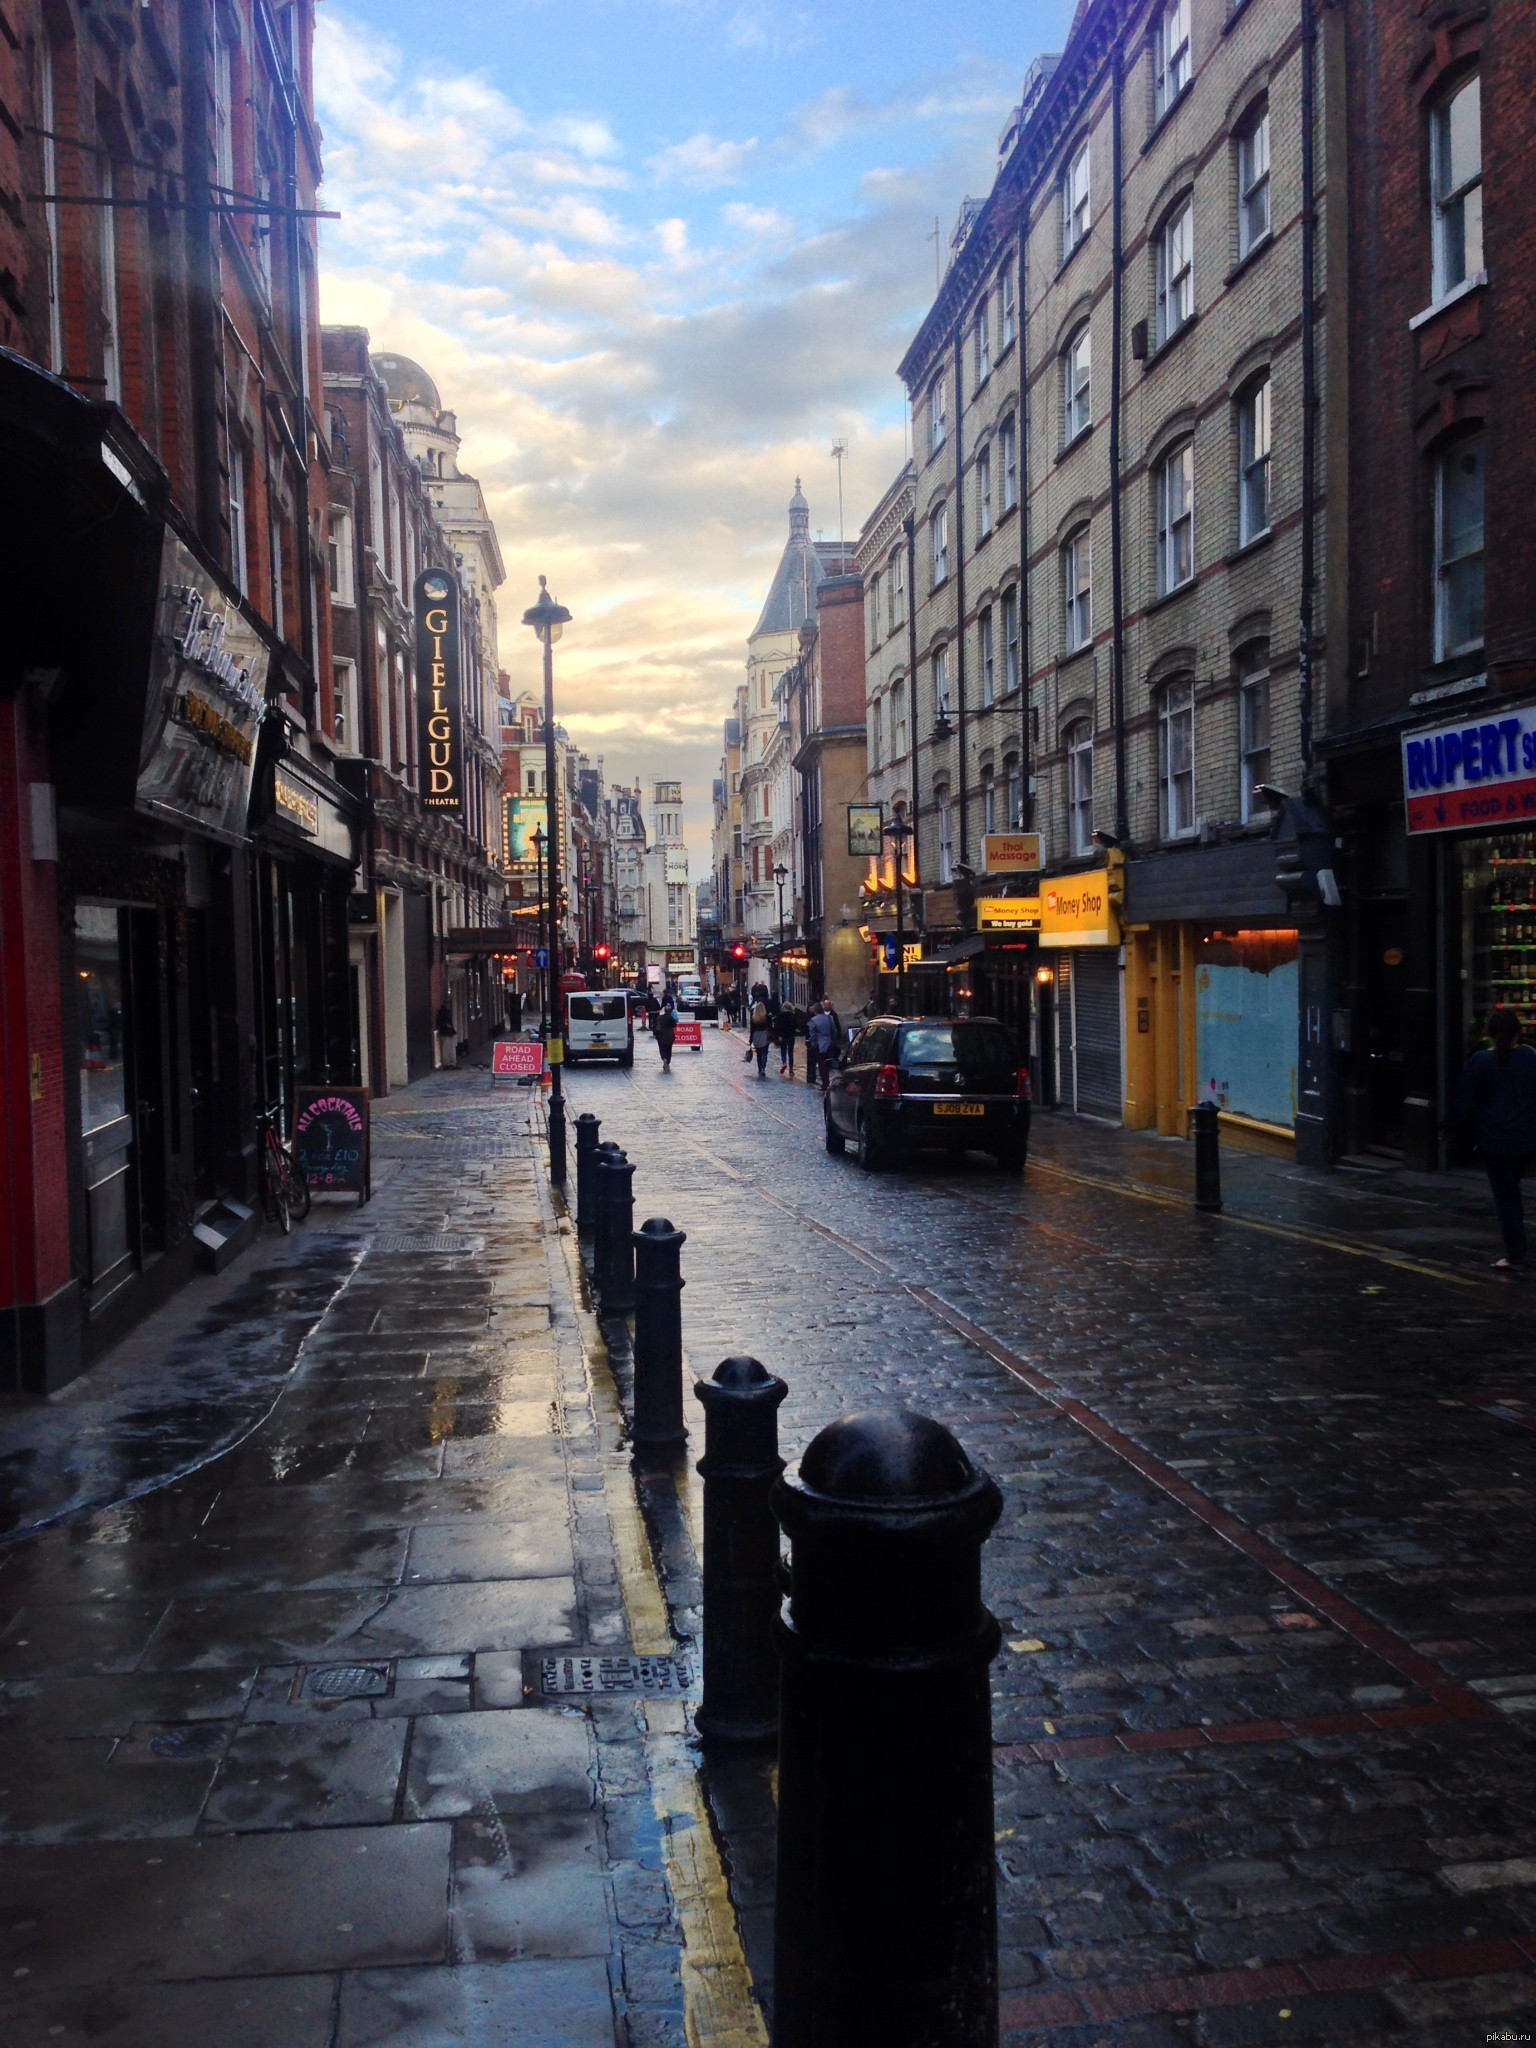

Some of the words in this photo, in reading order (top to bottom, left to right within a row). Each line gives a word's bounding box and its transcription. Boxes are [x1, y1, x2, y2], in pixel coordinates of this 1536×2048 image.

[425, 609, 453, 793] GIELGUD
[1406, 718, 1520, 790] RUPERT
[1522, 731, 1536, 770] S
[424, 797, 459, 805] THEATRE
[1460, 798, 1501, 818] FOOD
[1506, 796, 1517, 812] &
[1003, 842, 1023, 852] Thai
[990, 851, 1036, 861] Massage
[1056, 896, 1080, 918] Money
[1082, 893, 1102, 916] Shop
[1003, 920, 1015, 928] buy
[1017, 920, 1033, 928] gold
[505, 1045, 531, 1053] ROAD
[500, 1062, 536, 1071] CLOSED
[297, 1112, 313, 1131] ALL
[309, 1097, 363, 1131] COCKTAILS
[335, 1148, 359, 1160] £10
